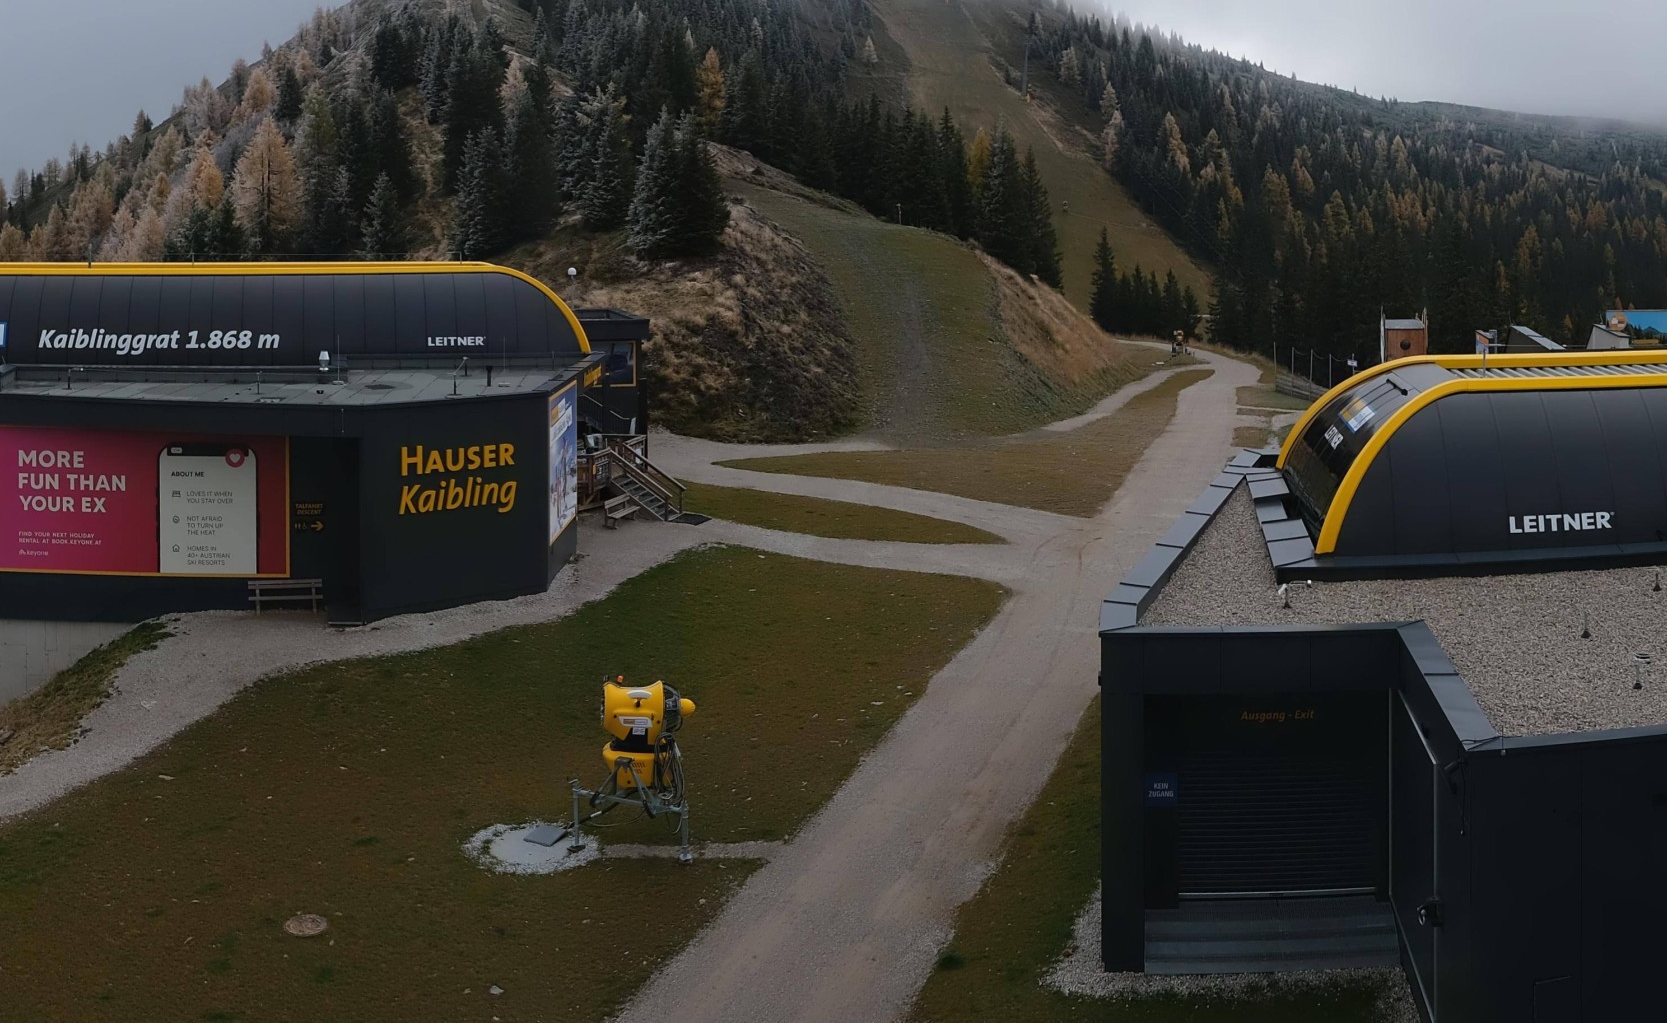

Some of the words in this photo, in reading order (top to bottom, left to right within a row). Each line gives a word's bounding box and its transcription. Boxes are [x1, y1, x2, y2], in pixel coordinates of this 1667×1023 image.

[38, 328, 180, 355] Kaiblinggrat
[185, 329, 252, 349] 1.868
[257, 333, 280, 349] m
[427, 336, 485, 347] LEITNER
[18, 450, 85, 468] MORE
[401, 443, 515, 476] HAUSER
[18, 473, 59, 490] FUN
[66, 474, 126, 492] THAN
[19, 495, 75, 512] YOUR
[81, 497, 107, 513] EX
[398, 476, 518, 515] Kaibling
[1508, 511, 1613, 534] LEITNER
[1240, 710, 1286, 723] Ausgang
[1294, 709, 1315, 719] Exit
[1148, 790, 1174, 798] ZUGANG
